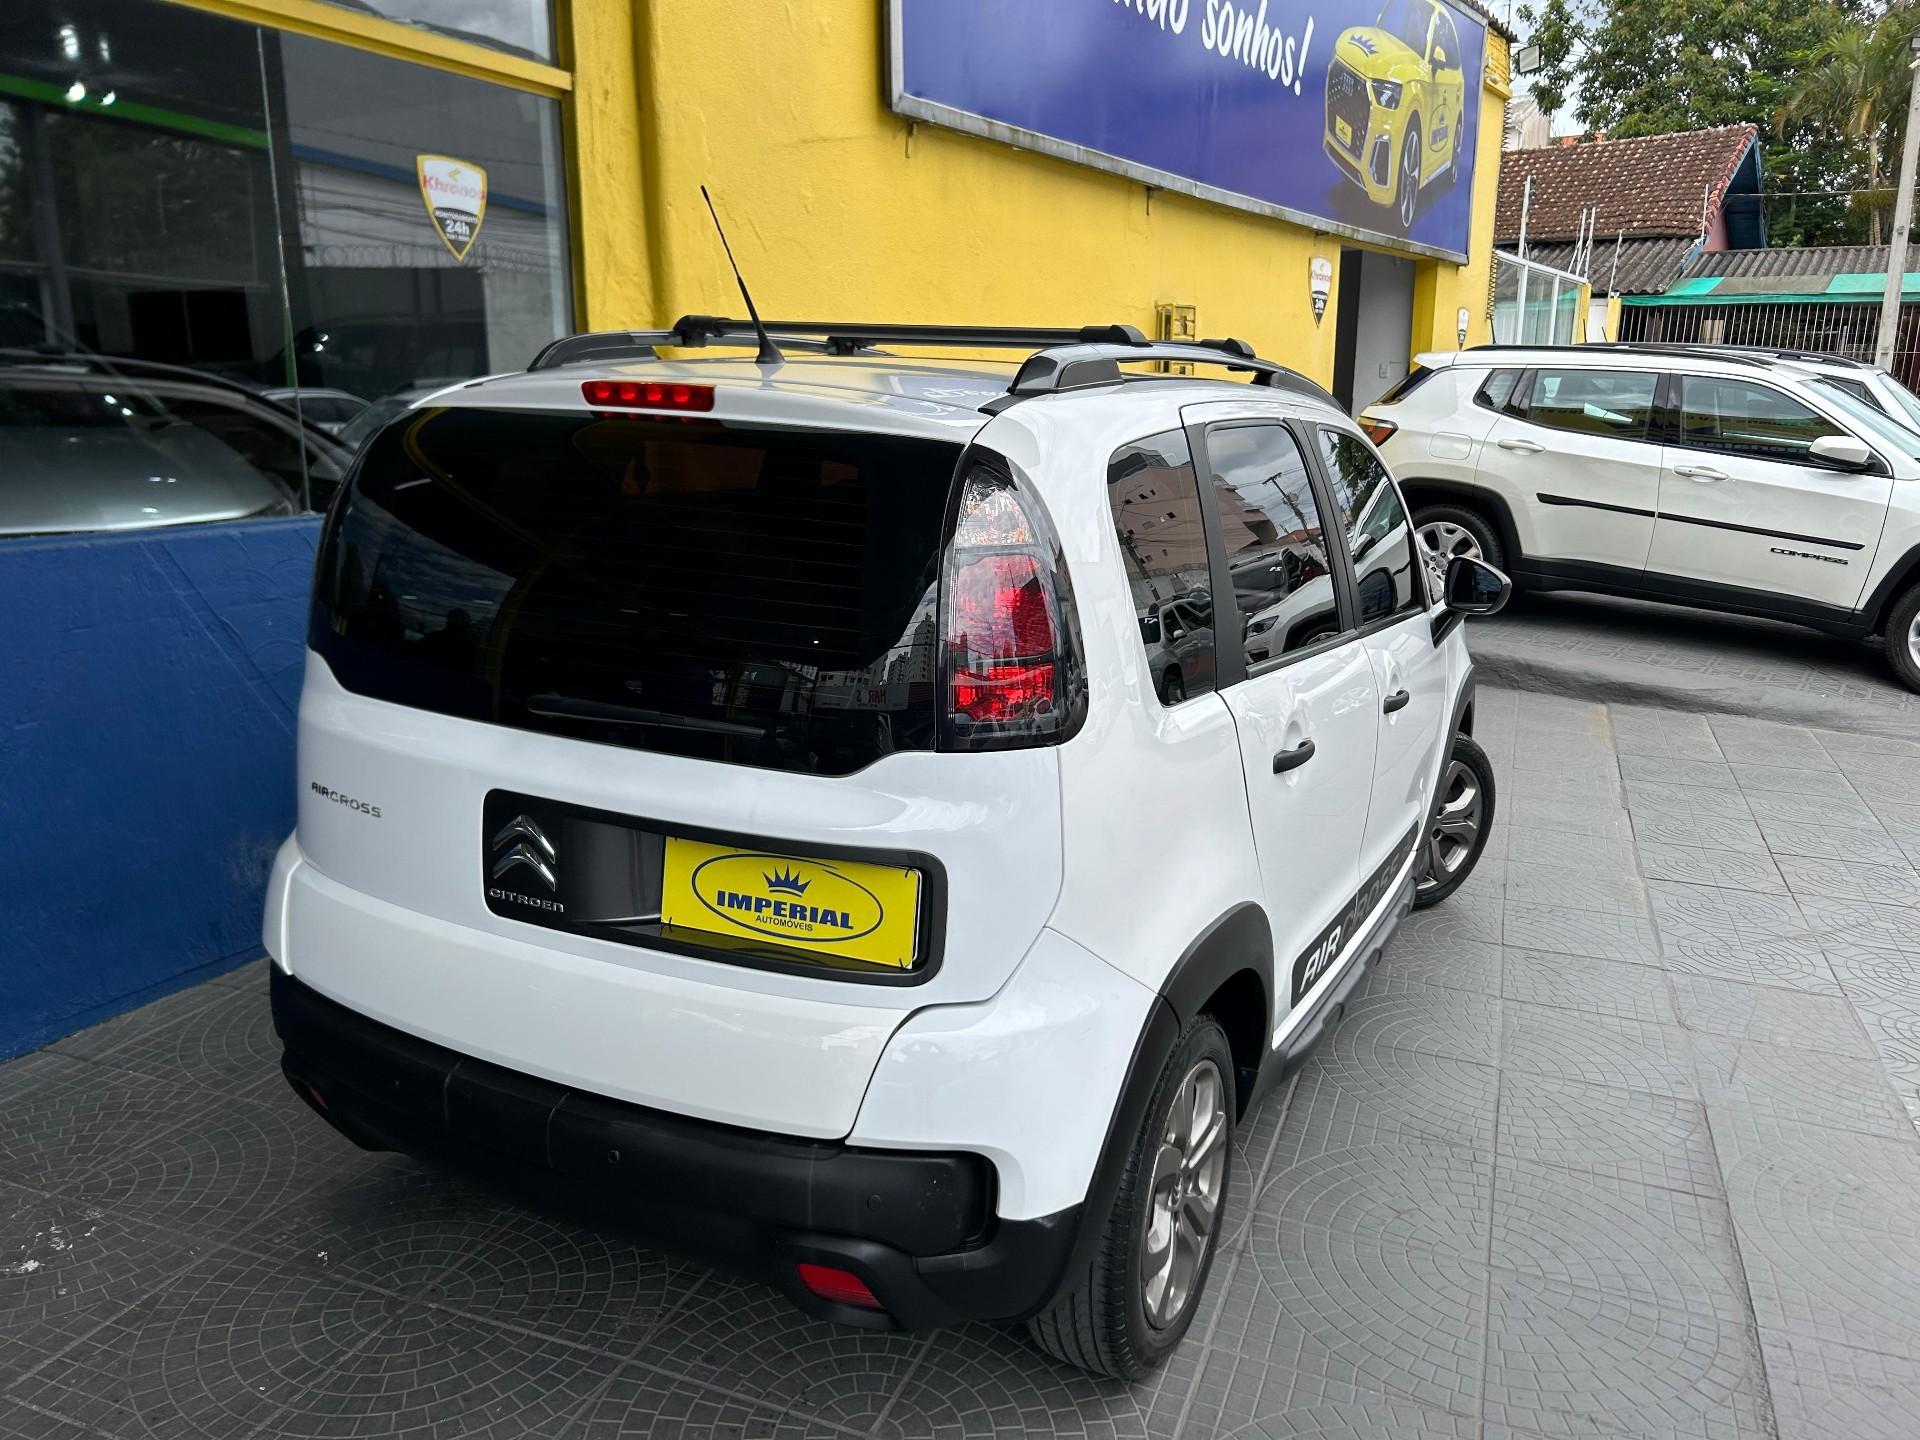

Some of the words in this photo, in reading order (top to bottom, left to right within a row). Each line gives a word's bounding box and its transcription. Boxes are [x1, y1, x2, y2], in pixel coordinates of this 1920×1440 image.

[1201, 0, 1314, 97] sonhos!
[444, 219, 471, 235] 24h
[1770, 546, 1849, 565] COMPASS
[311, 781, 383, 818] AIRCROSS
[716, 889, 854, 930] IMPERIAL
[755, 913, 814, 932] AUTOMÓVEIS
